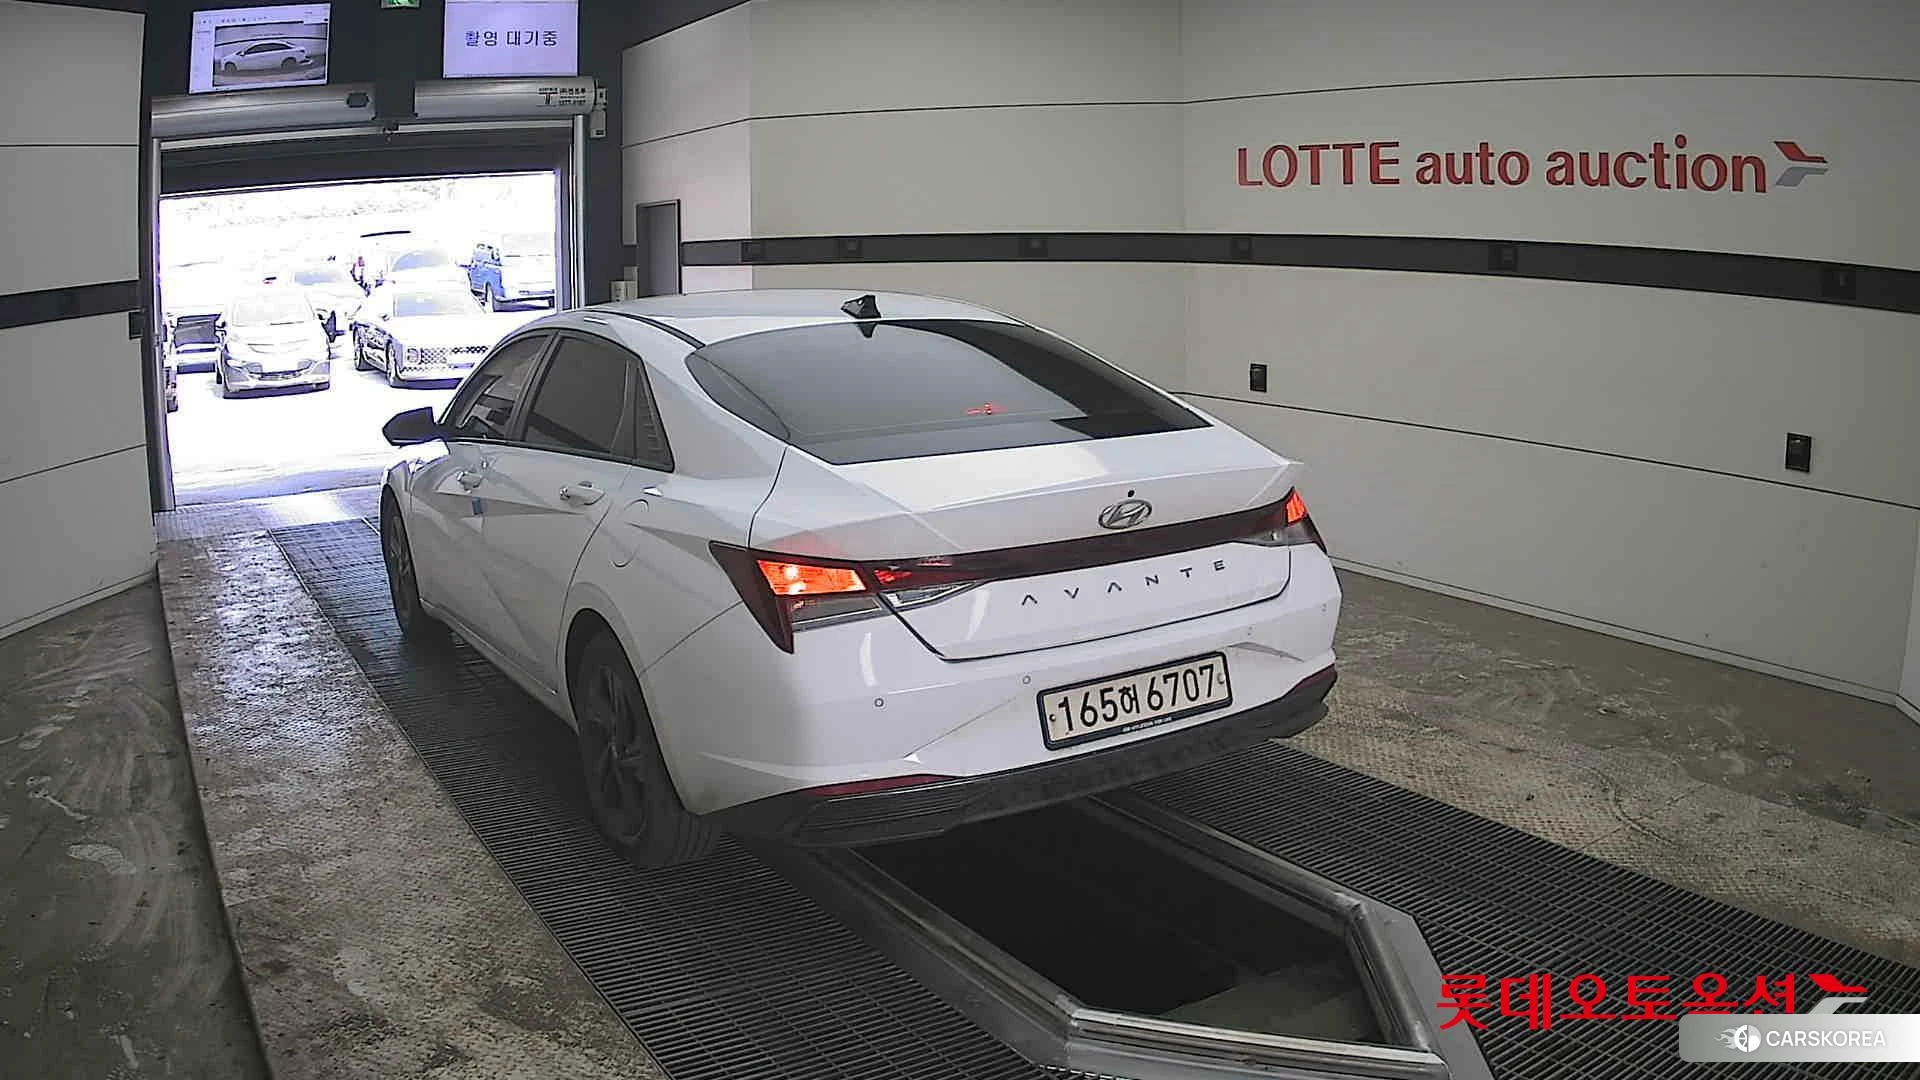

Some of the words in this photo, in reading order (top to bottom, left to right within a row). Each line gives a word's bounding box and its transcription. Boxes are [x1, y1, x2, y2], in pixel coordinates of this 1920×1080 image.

[506, 30, 558, 47] 대기중
[1237, 141, 1400, 187] LOTTE
[1415, 142, 1531, 186] auto
[1546, 134, 1767, 193] auction
[1021, 560, 1227, 606] AVANTE
